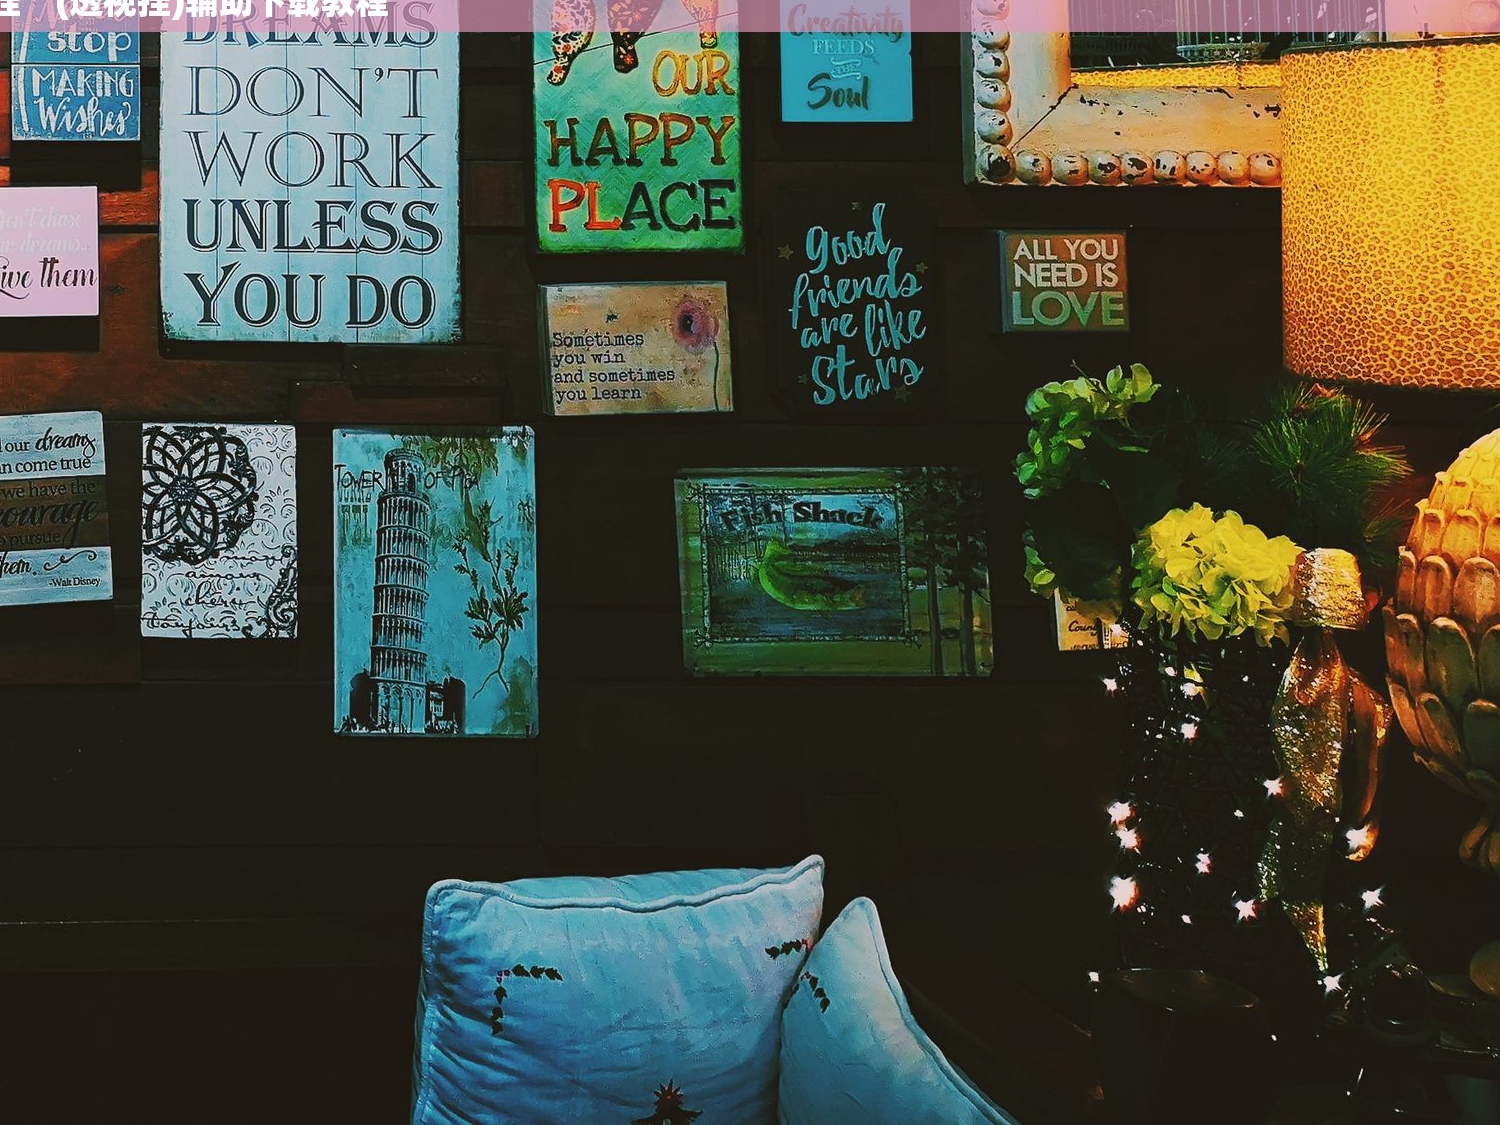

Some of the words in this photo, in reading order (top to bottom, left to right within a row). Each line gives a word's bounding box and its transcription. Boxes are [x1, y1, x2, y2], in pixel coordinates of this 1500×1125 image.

[32, 67, 133, 98] MAKING
[184, 66, 438, 118] DON'T
[808, 73, 868, 110] Soul
[545, 114, 735, 166] HAPPY
[184, 131, 442, 189] WORK
[549, 179, 736, 232] PLACE
[184, 199, 444, 254] UNLESS
[1014, 238, 1057, 261] ALL
[1067, 238, 1119, 260] YOU
[1014, 264, 1088, 288] NEED
[1096, 264, 1118, 287] IS
[184, 262, 325, 328] YOU
[345, 276, 435, 328] DO
[1012, 291, 1124, 327] LOVE
[553, 330, 644, 347] Sometimes
[16, 460, 57, 473] come
[60, 457, 91, 470] true
[335, 465, 385, 491] TOWER
